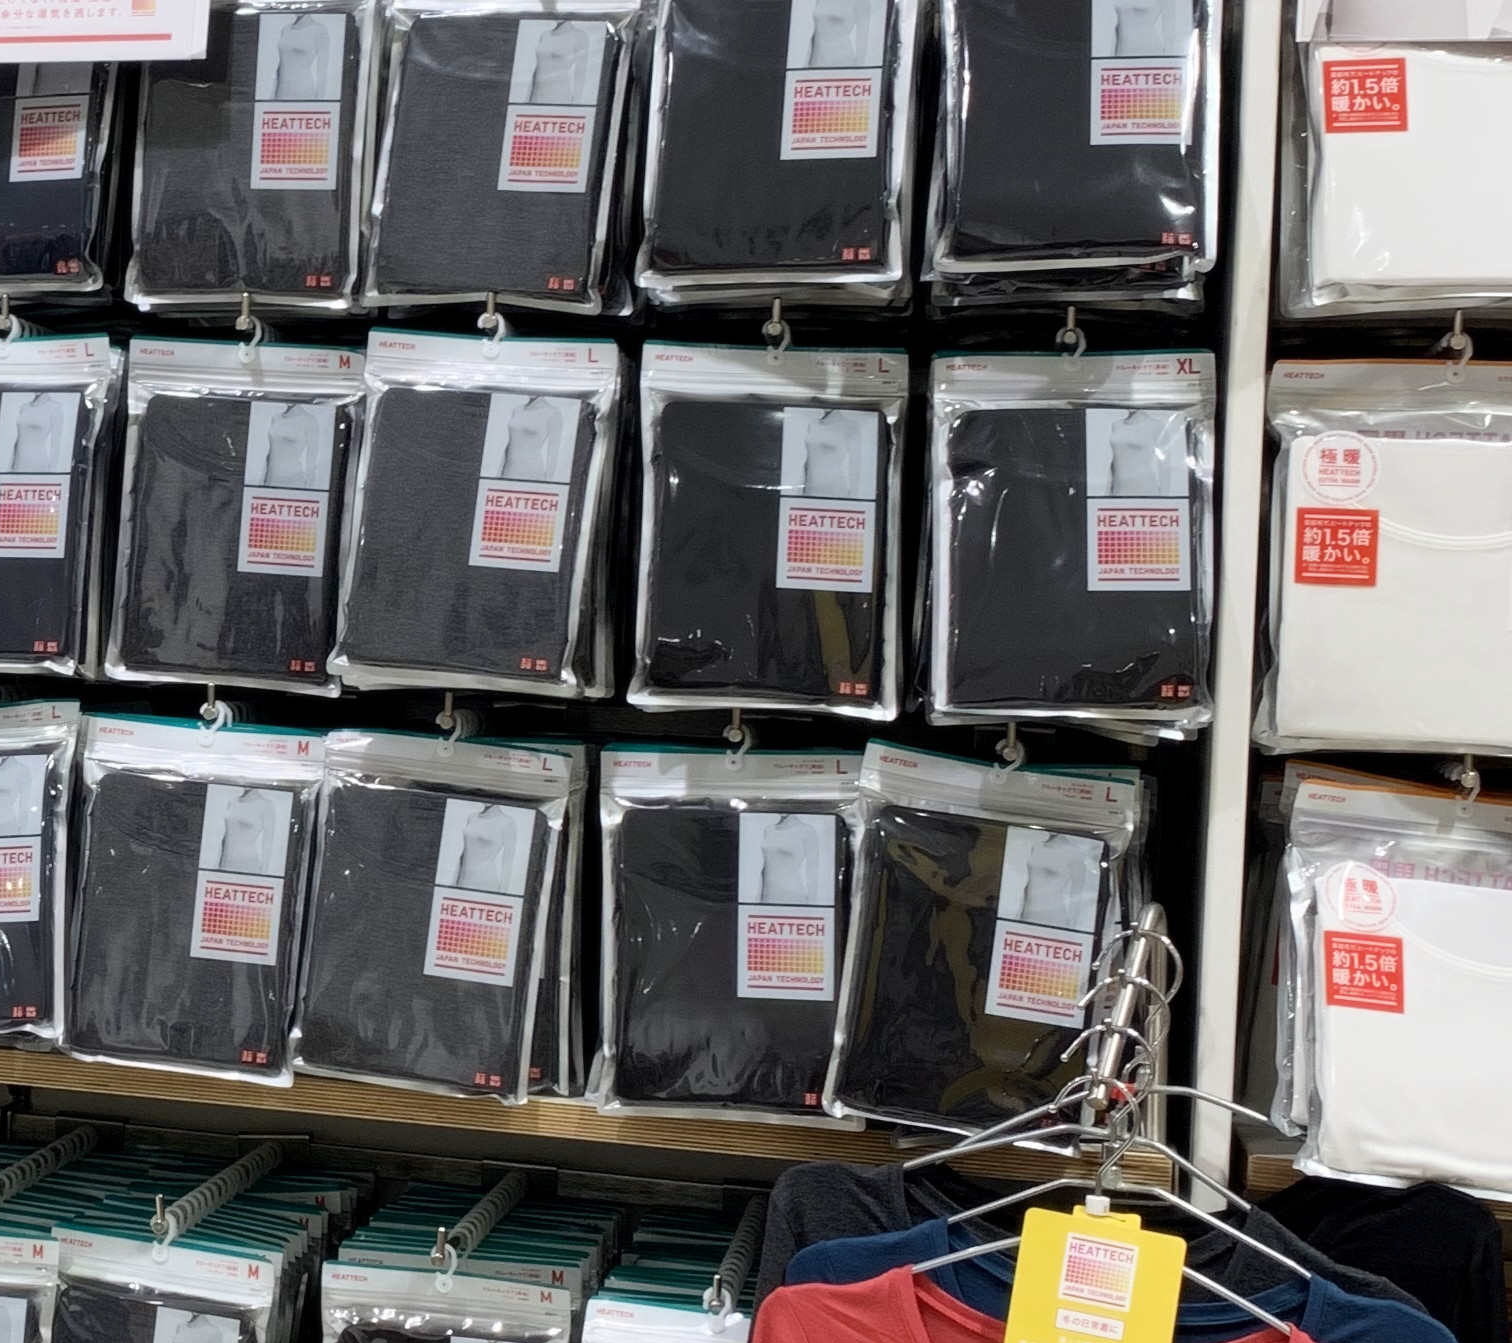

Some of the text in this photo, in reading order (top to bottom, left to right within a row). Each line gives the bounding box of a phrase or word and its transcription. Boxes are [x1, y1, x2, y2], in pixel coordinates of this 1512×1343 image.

[1101, 73, 1182, 87] HEATTECH
[1331, 77, 1402, 95] 約1.5倍
[794, 84, 871, 99] HEATTECH
[1331, 96, 1400, 112] 暖かい。
[20, 109, 80, 125] HEATTECH
[261, 118, 330, 131] HEATTECH
[514, 120, 585, 134] HEATTECH
[339, 356, 350, 369] M
[879, 359, 889, 373] L
[1176, 359, 1200, 374] XL
[1283, 372, 1325, 380] HEATTECH
[250, 502, 319, 519] HEATTECH
[486, 494, 558, 513] HEATTECH
[788, 514, 865, 529] HEATTECH
[1097, 515, 1179, 528] HEATTECH
[1303, 527, 1373, 546] 約1.5倍
[1302, 546, 1370, 564] 暖かい。
[1098, 566, 1179, 576] JAPAN TECHNOLOGY
[298, 741, 309, 756] M
[836, 760, 847, 774] L
[1106, 787, 1117, 802] L
[205, 886, 274, 905] HEATTECH
[440, 903, 512, 924] HEATTECH
[748, 921, 825, 937] HEATTECH
[1003, 938, 1082, 963] HEATTECH
[1332, 950, 1399, 973] 約1.5倍
[748, 975, 824, 984] JAPAN TECHNOLOGY
[1332, 968, 1398, 991] 暖かい。
[32, 1245, 43, 1258] M
[1069, 1242, 1134, 1264] HEATTECH
[248, 1264, 259, 1279] M
[540, 1291, 552, 1304] M
